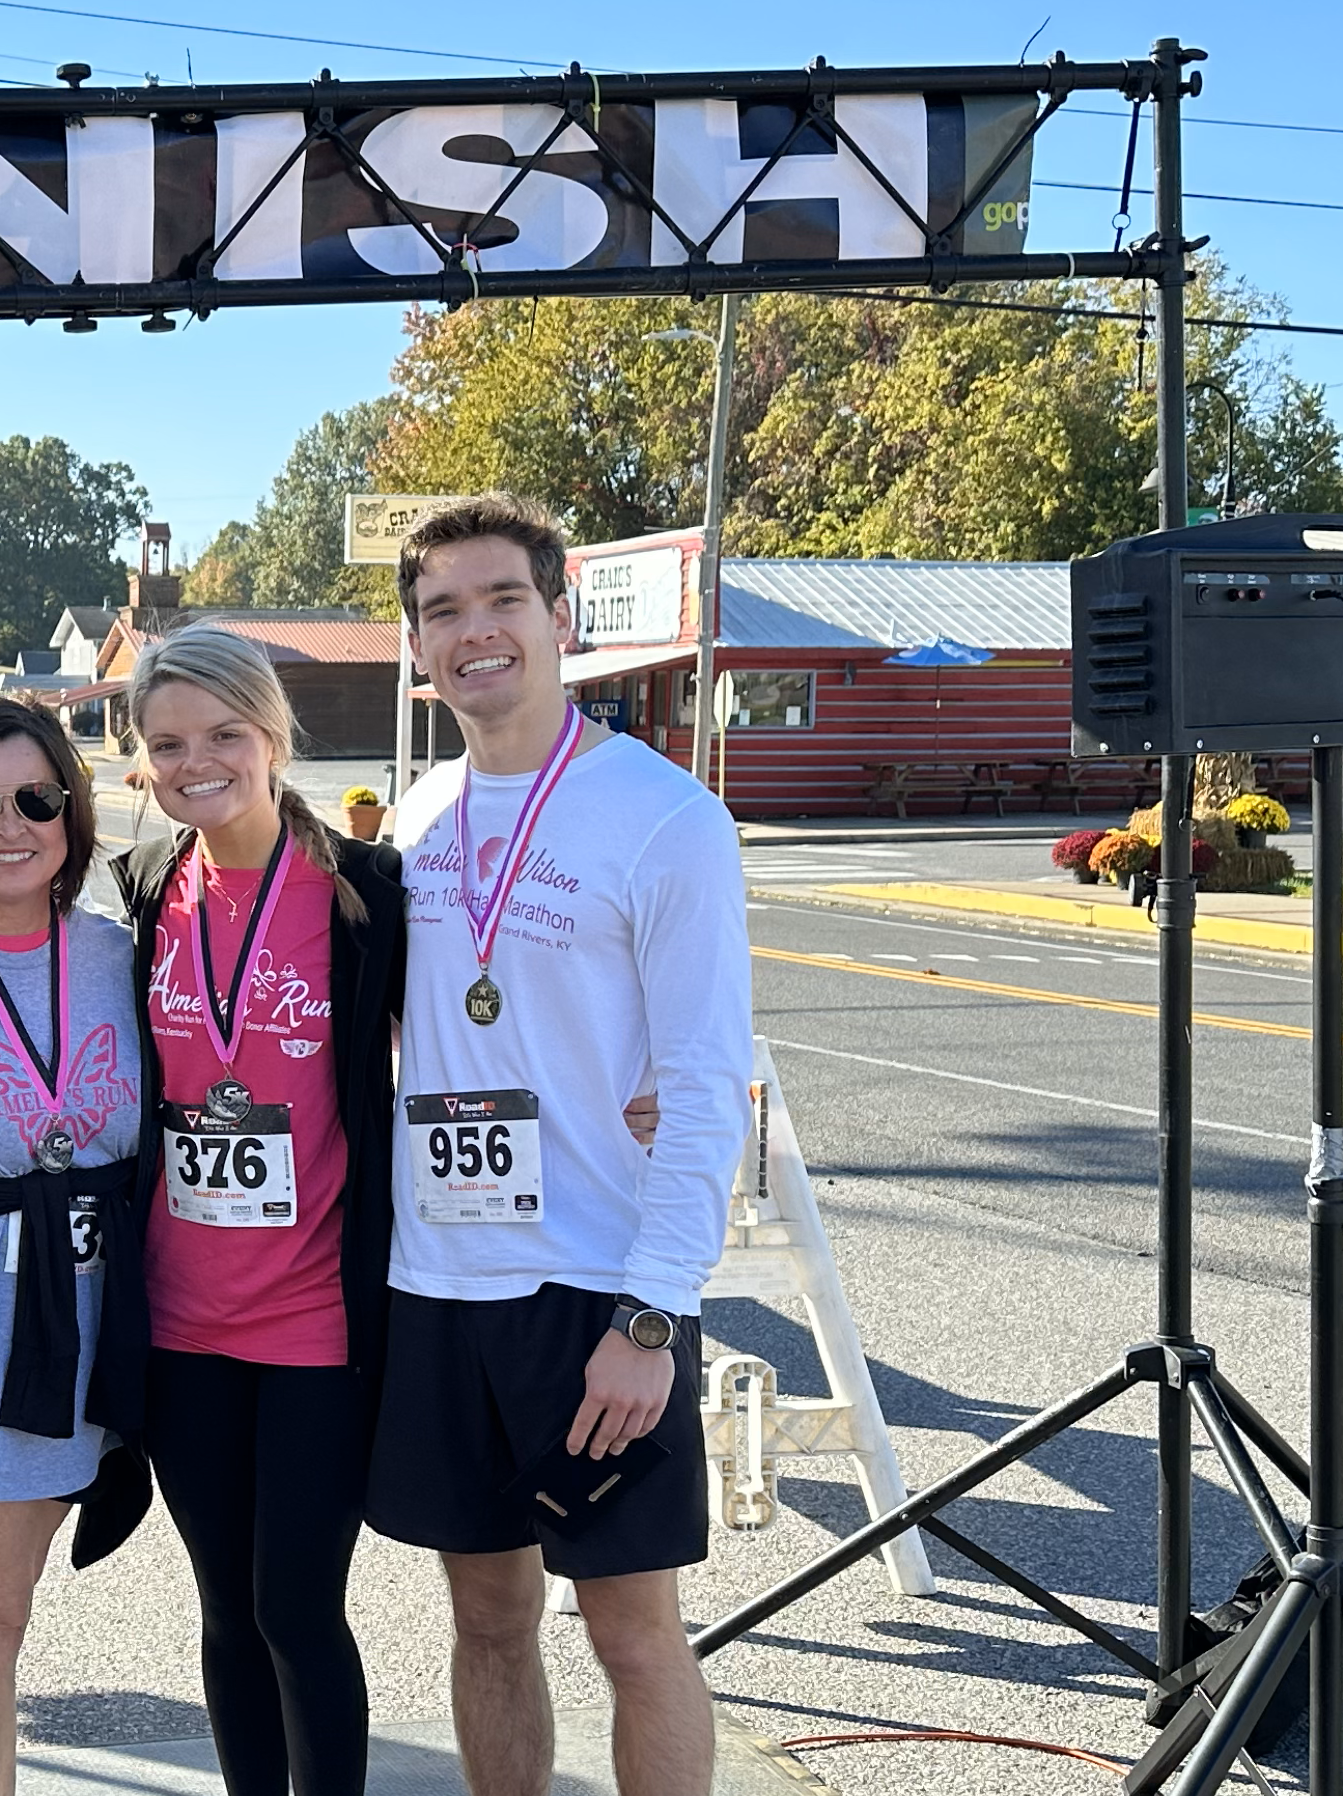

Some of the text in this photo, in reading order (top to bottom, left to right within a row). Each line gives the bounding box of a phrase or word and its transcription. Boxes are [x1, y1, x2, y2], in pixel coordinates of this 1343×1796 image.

[586, 594, 636, 634] DAIRY
[593, 705, 616, 715] ATM
[409, 886, 436, 907] Run
[556, 939, 572, 952] KY
[271, 979, 333, 1028] Run
[470, 998, 493, 1018] 10K
[92, 1078, 138, 1107] RUN
[222, 1086, 250, 1105] 5K
[459, 1101, 496, 1112] RoadID
[428, 1124, 513, 1178] 956
[175, 1135, 267, 1189] 376
